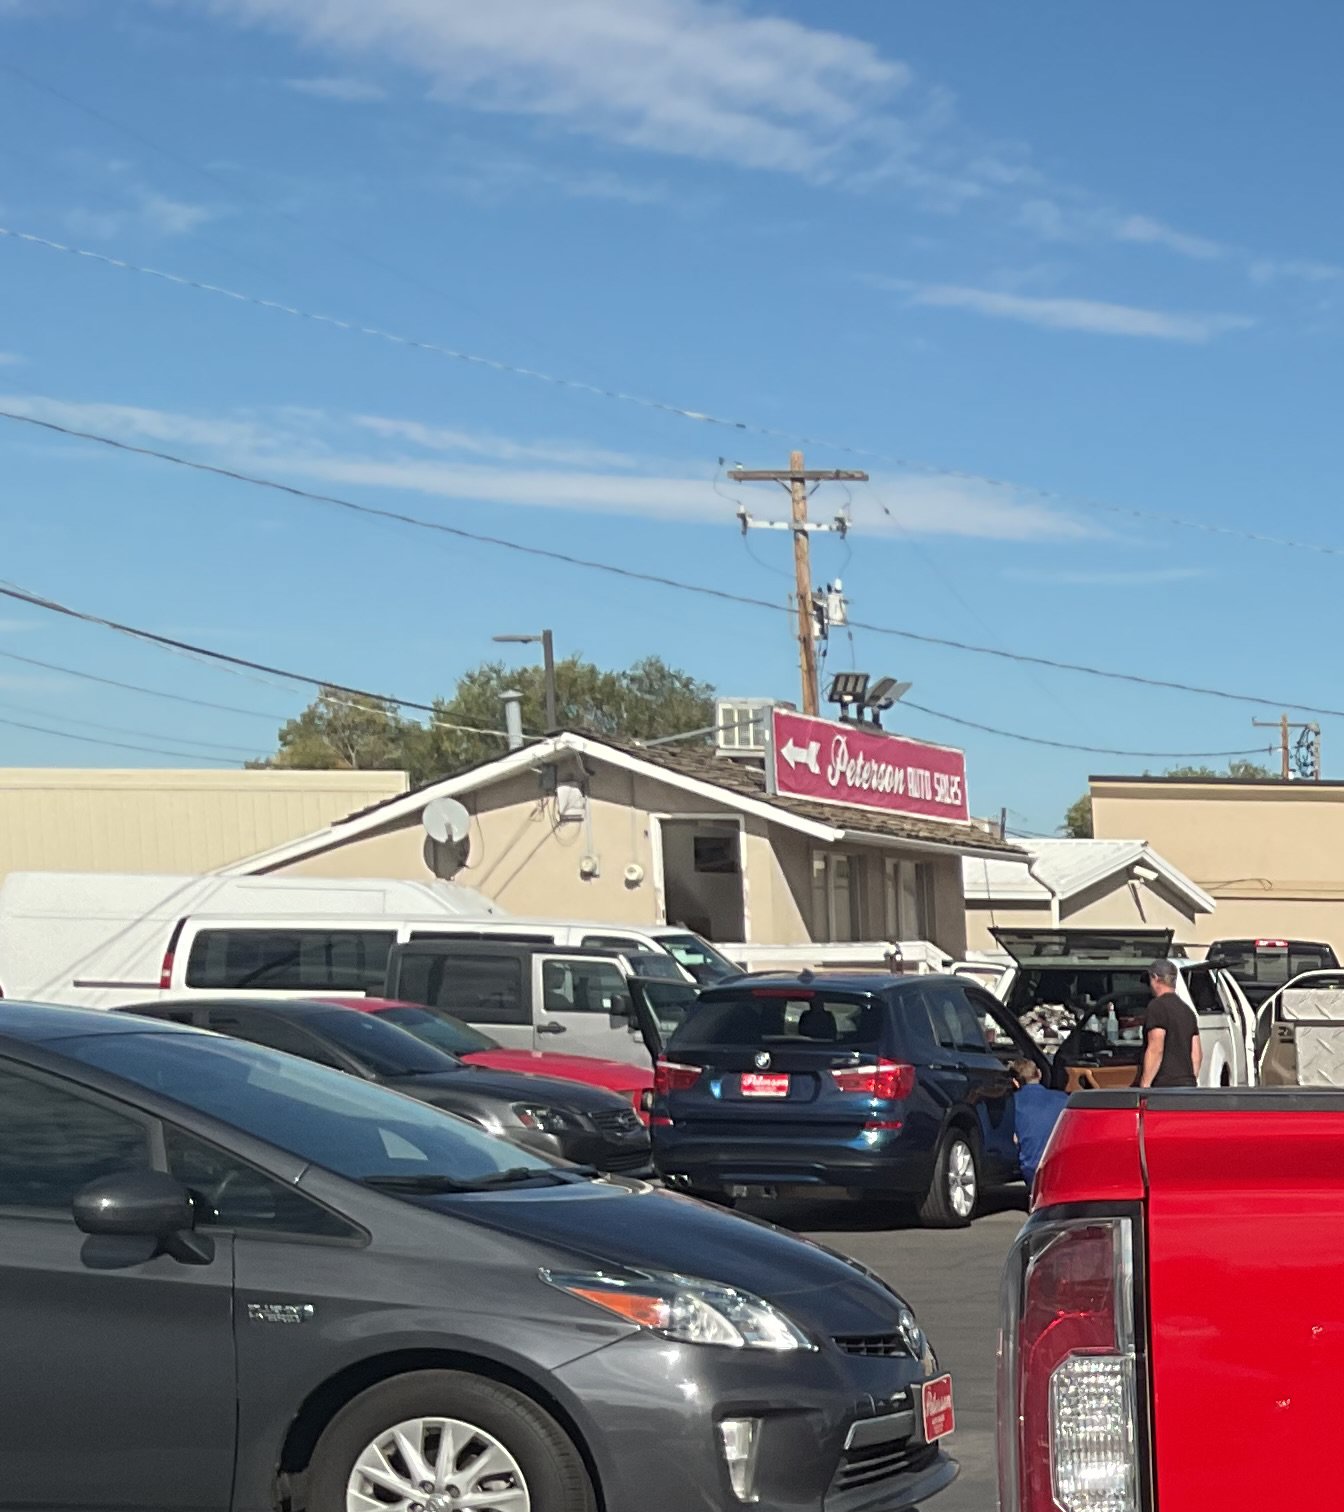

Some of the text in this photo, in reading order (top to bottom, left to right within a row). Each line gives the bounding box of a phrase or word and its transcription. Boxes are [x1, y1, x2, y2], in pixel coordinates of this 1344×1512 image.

[827, 734, 962, 806] Peterson AUTO SALES
